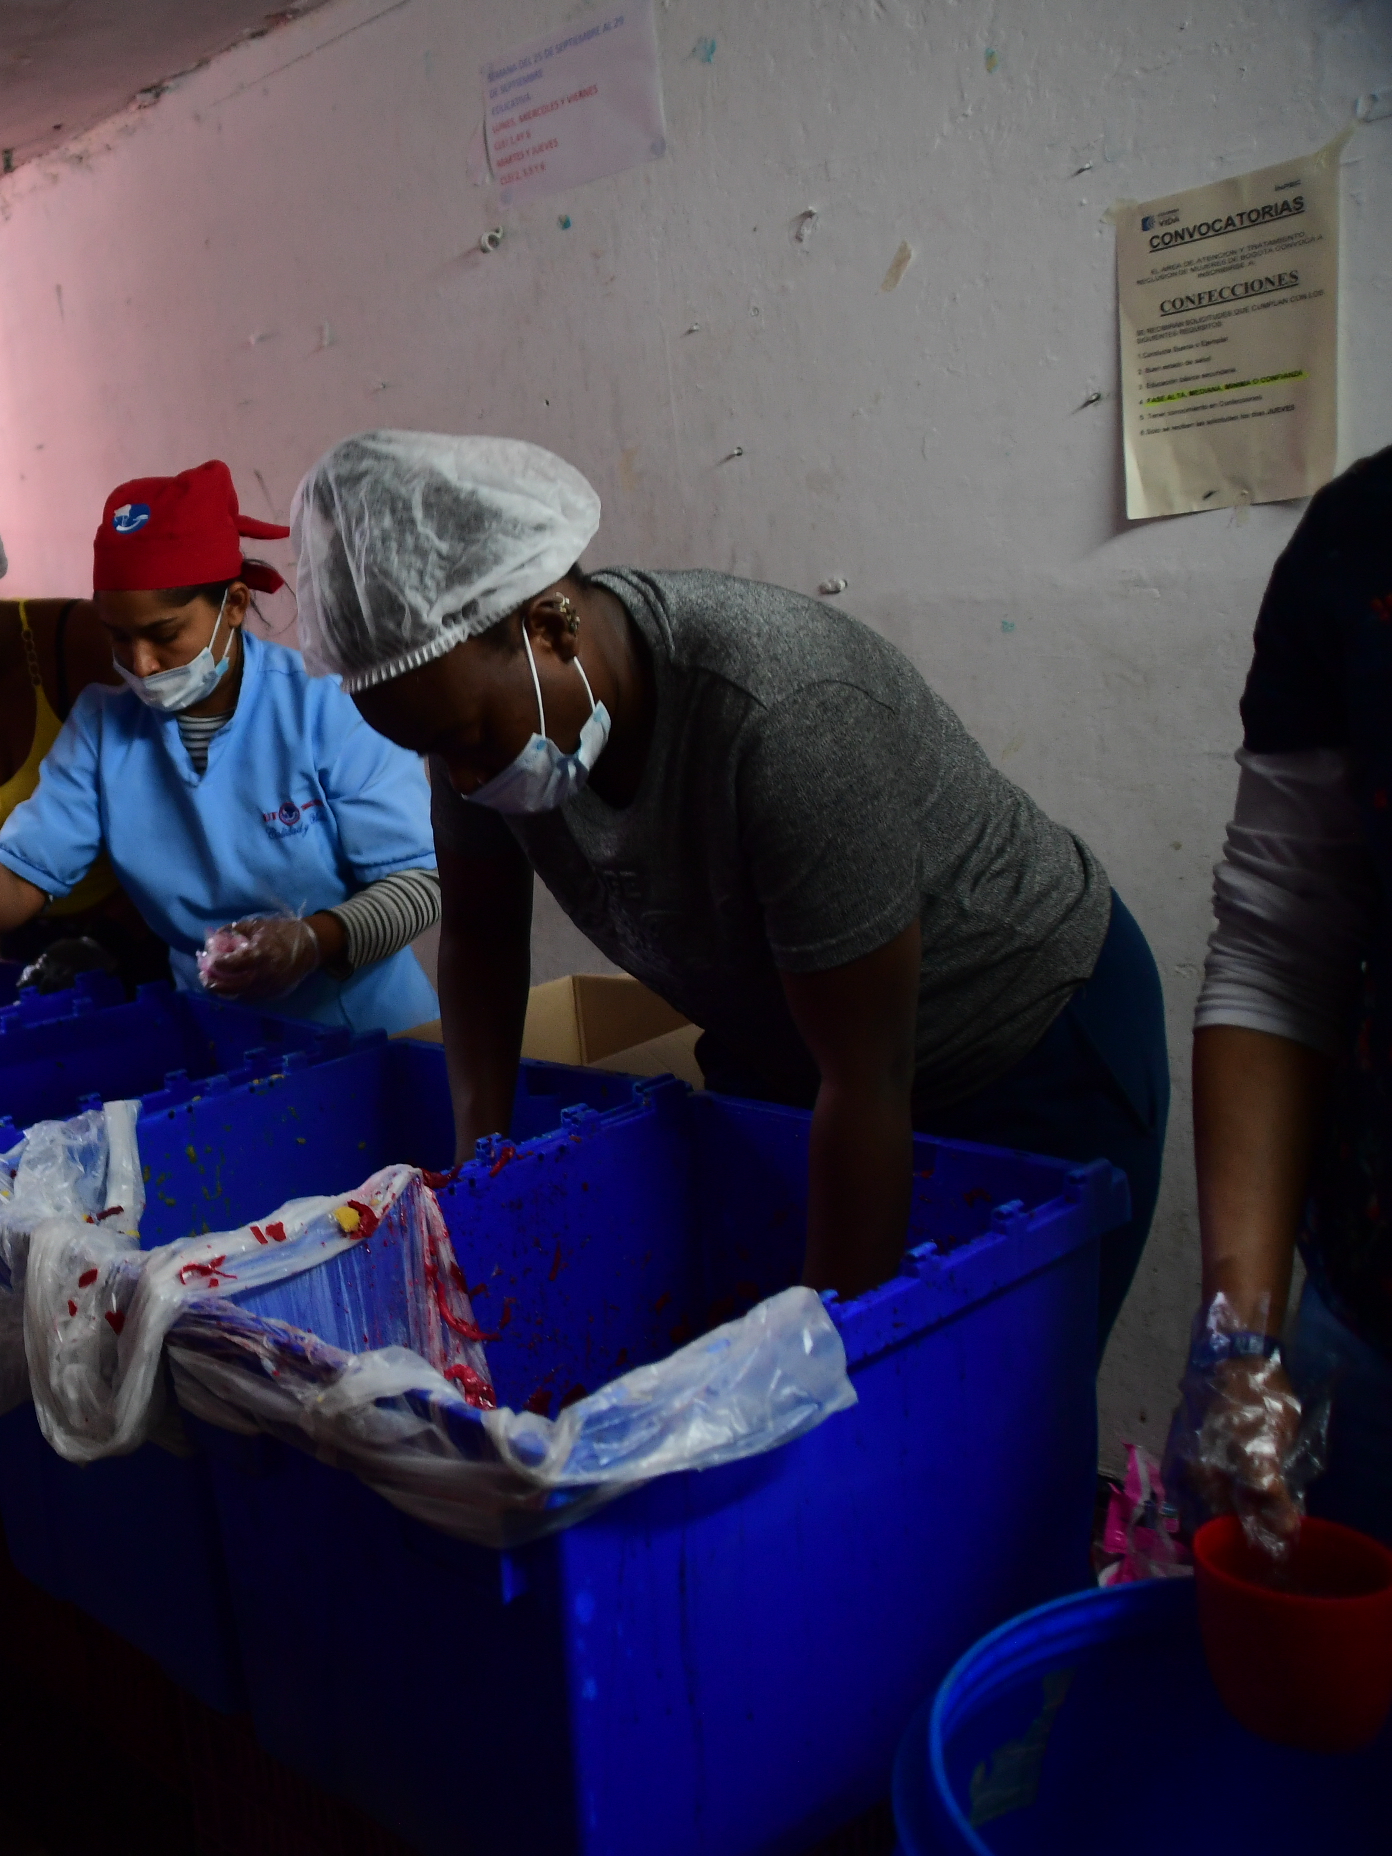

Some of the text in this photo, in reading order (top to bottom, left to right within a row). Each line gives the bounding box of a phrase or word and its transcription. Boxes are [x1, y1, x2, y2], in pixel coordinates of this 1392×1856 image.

[487, 64, 517, 82] SEMANA
[519, 58, 532, 69] DEL
[544, 47, 554, 59] DE
[555, 27, 600, 54] SEPTIEMBRE
[603, 22, 612, 34] AL
[490, 69, 543, 99] DE SEPTIEMBRE
[567, 85, 599, 104] VIERNES
[497, 150, 524, 168] MARTES
[532, 138, 559, 156] JUEVES
[1149, 196, 1304, 249] CONVOCATORIAS
[1159, 216, 1180, 227] VIDA
[1248, 232, 1305, 251] TRATAMIENTO
[1137, 271, 1178, 285] RECLUSION
[1178, 267, 1189, 276] DE
[1191, 258, 1227, 273] MUJERES
[1228, 255, 1239, 265] DE
[1241, 247, 1274, 261] BOGOTA
[1275, 237, 1315, 252] CONVOCA
[1198, 263, 1245, 278] INSCRIBIRSE
[1159, 270, 1299, 314] CONFECCIONES
[1186, 310, 1233, 327] SOLICITUDES
[1234, 307, 1250, 317] QUE
[1252, 298, 1289, 313] CUMPLAN
[1290, 293, 1308, 304] CON
[1309, 289, 1325, 300] LOS
[1260, 370, 1303, 384] CONFIANZA
[1267, 403, 1296, 416] JUEVES
